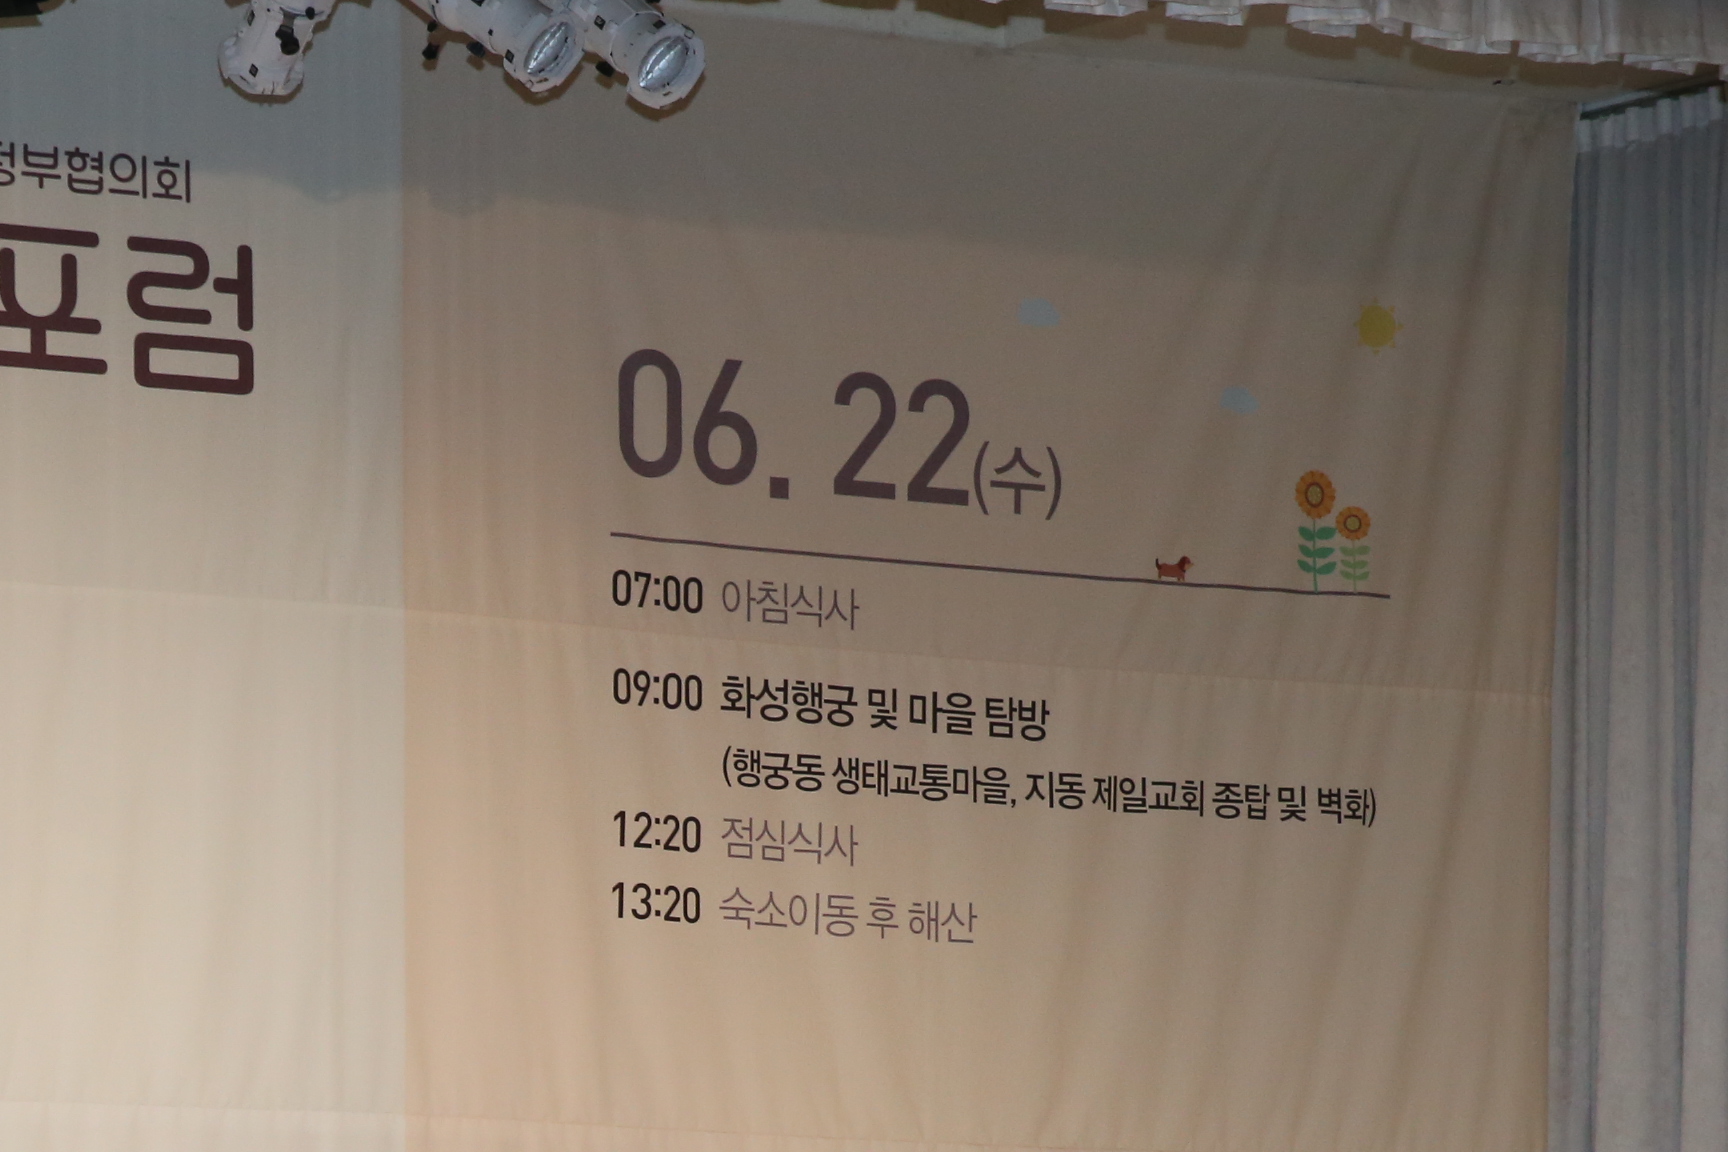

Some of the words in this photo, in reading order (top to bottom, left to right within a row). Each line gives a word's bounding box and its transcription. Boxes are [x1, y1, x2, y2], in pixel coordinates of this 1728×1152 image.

[618, 349, 790, 500] 06.
[833, 371, 1062, 520] 22(수)
[612, 569, 703, 614] 07:00
[722, 579, 860, 630] 아침식사
[613, 667, 703, 711] 09:00
[720, 676, 858, 727] 화성행궁
[867, 687, 898, 730] 및
[909, 691, 976, 735] 마을
[985, 696, 1050, 742] 탐방
[722, 746, 825, 792] (행궁동
[832, 756, 1016, 808] 생태교통마을,
[1025, 771, 1086, 810] 지동
[1092, 775, 1204, 817] 제일교회
[1212, 781, 1270, 820] 종탑
[1277, 786, 1307, 822] 및
[1318, 787, 1376, 828] 벽화)
[613, 810, 702, 853] 12:20
[722, 817, 859, 867] 점심식사
[611, 882, 701, 924] 13:20
[719, 887, 859, 937] 숙소이동
[866, 896, 899, 939] 후
[908, 901, 978, 944] 해산
